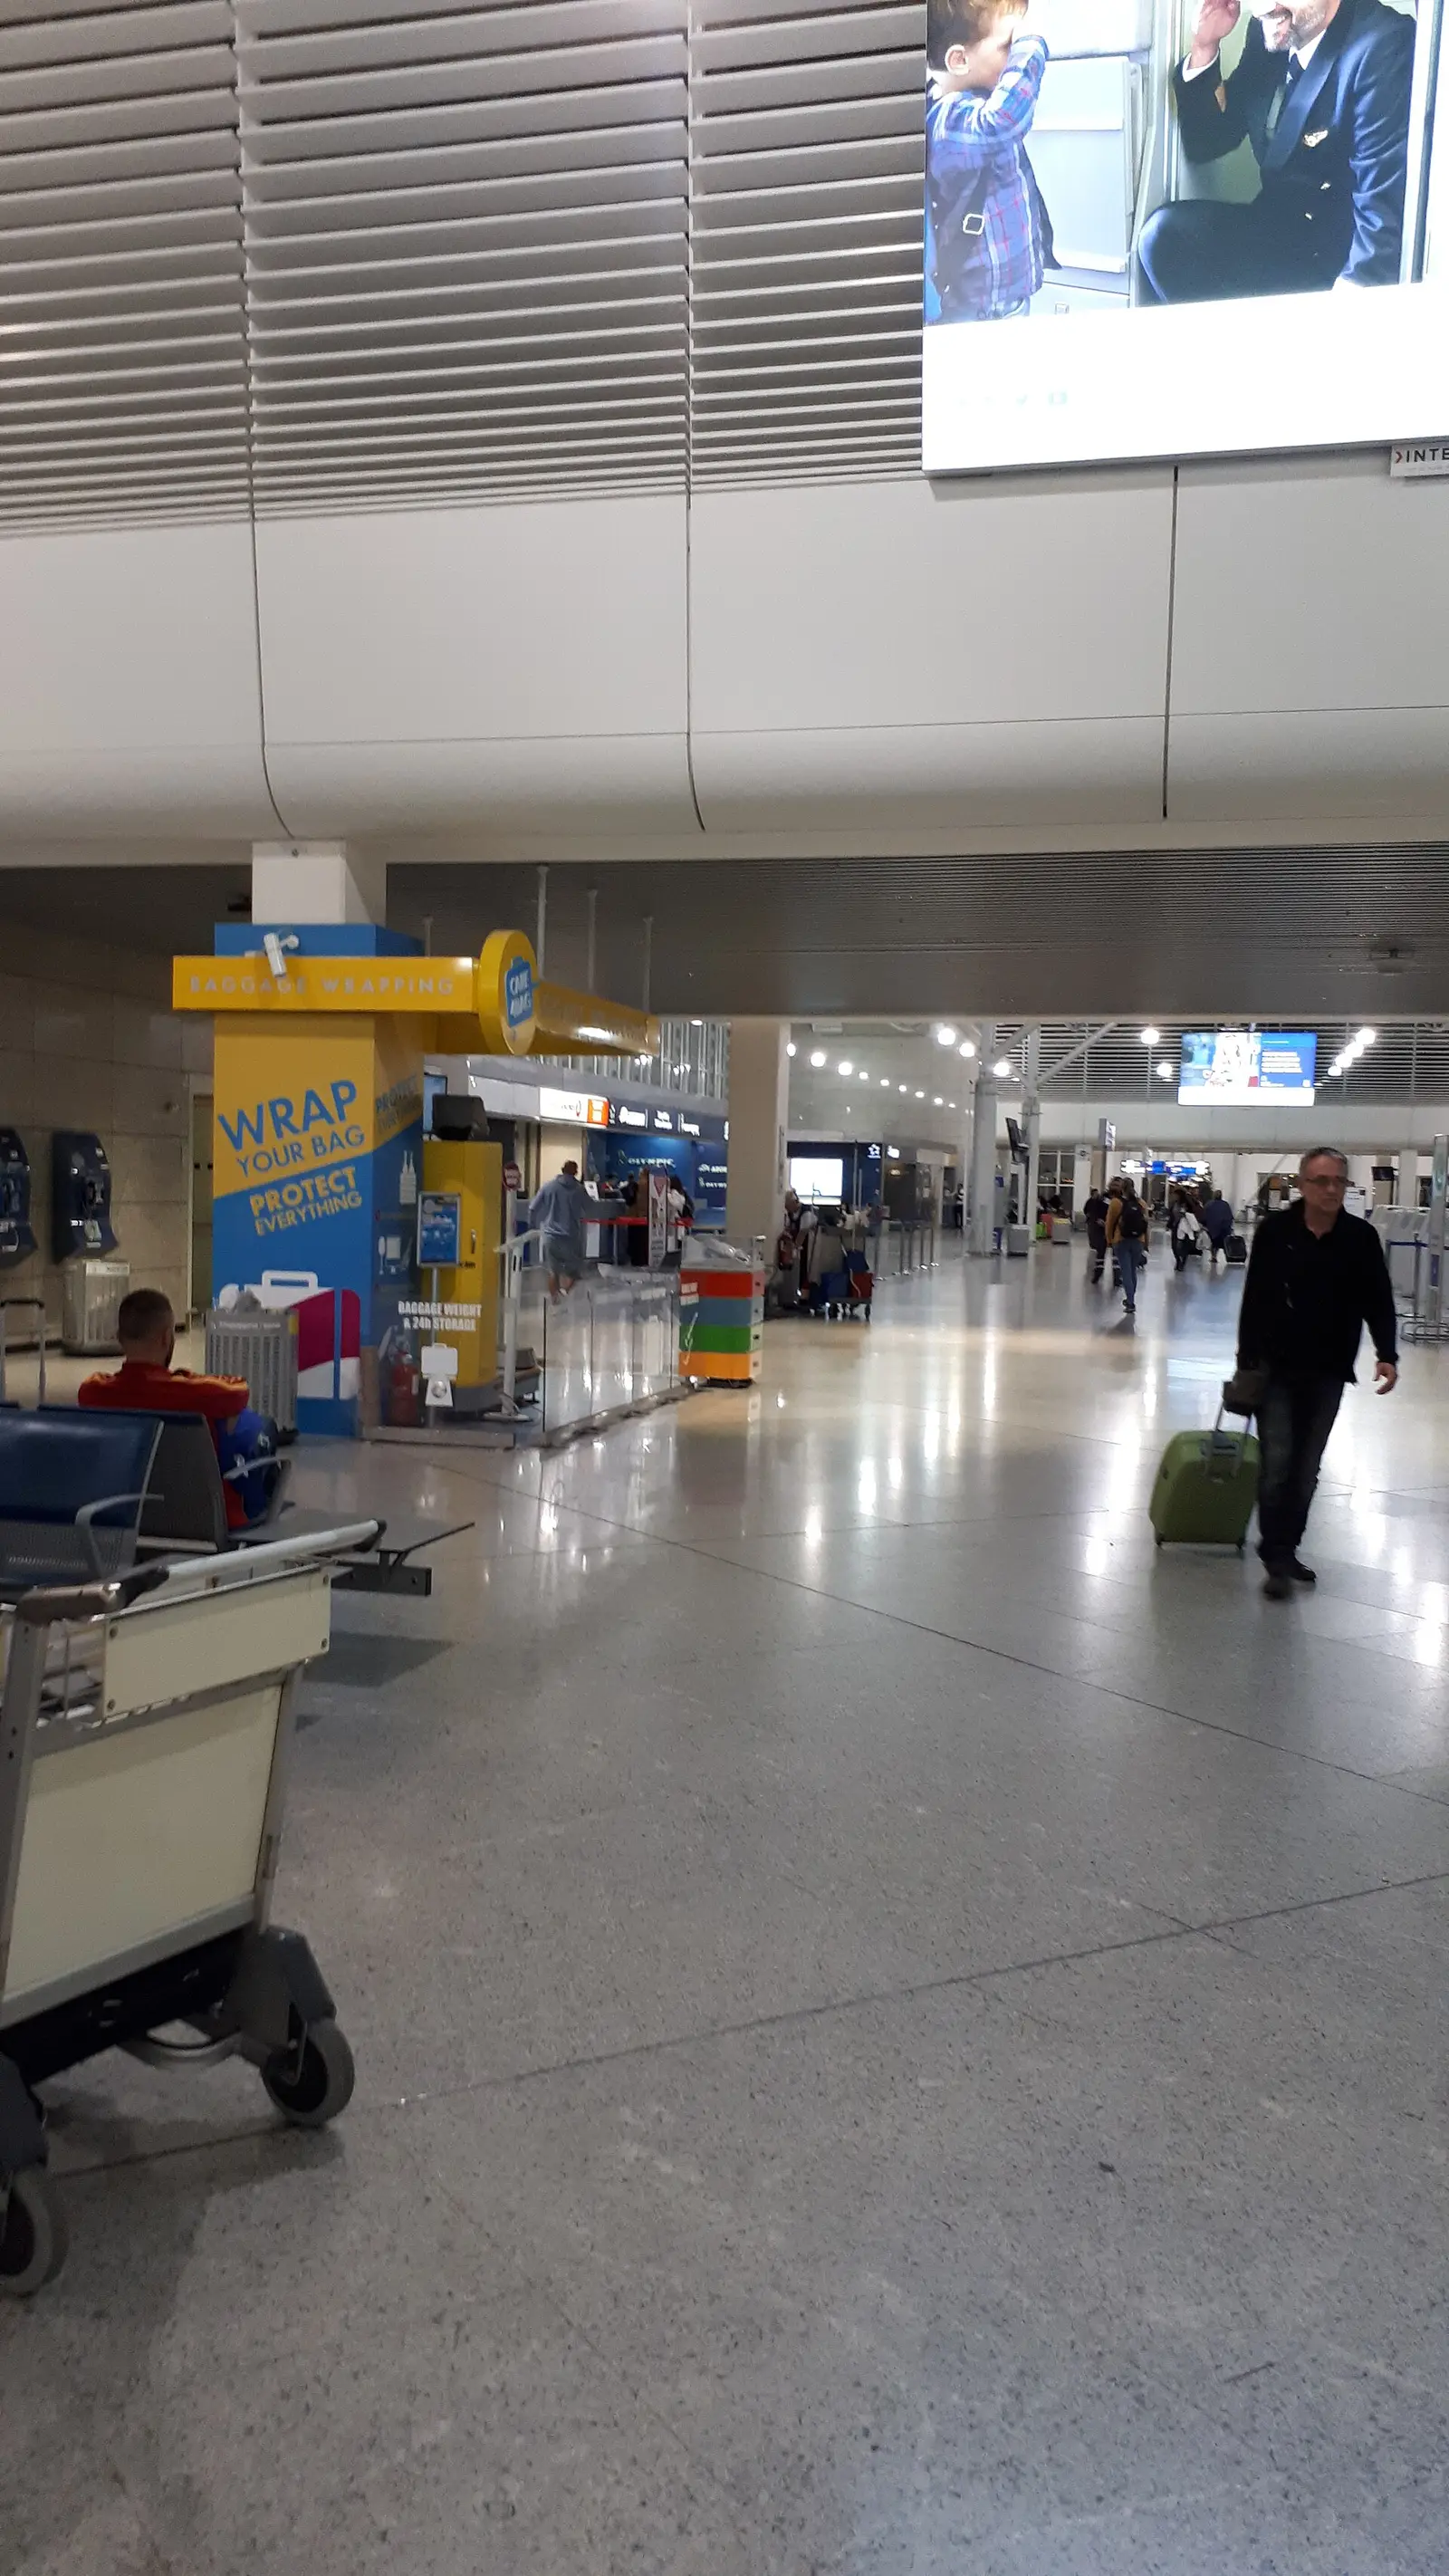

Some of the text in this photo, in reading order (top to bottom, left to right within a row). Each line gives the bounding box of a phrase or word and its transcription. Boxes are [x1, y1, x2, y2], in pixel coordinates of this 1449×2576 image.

[189, 975, 454, 995] BAGGAGE WRAPPING
[217, 1079, 358, 1153] WRAP
[236, 1124, 366, 1178] YOUR BAG
[249, 1165, 357, 1218] PROTECT
[254, 1190, 362, 1237] EVERYTHING
[398, 1300, 483, 1318] BAGGAGE WEIGHT
[432, 1317, 476, 1332] STORAGE
